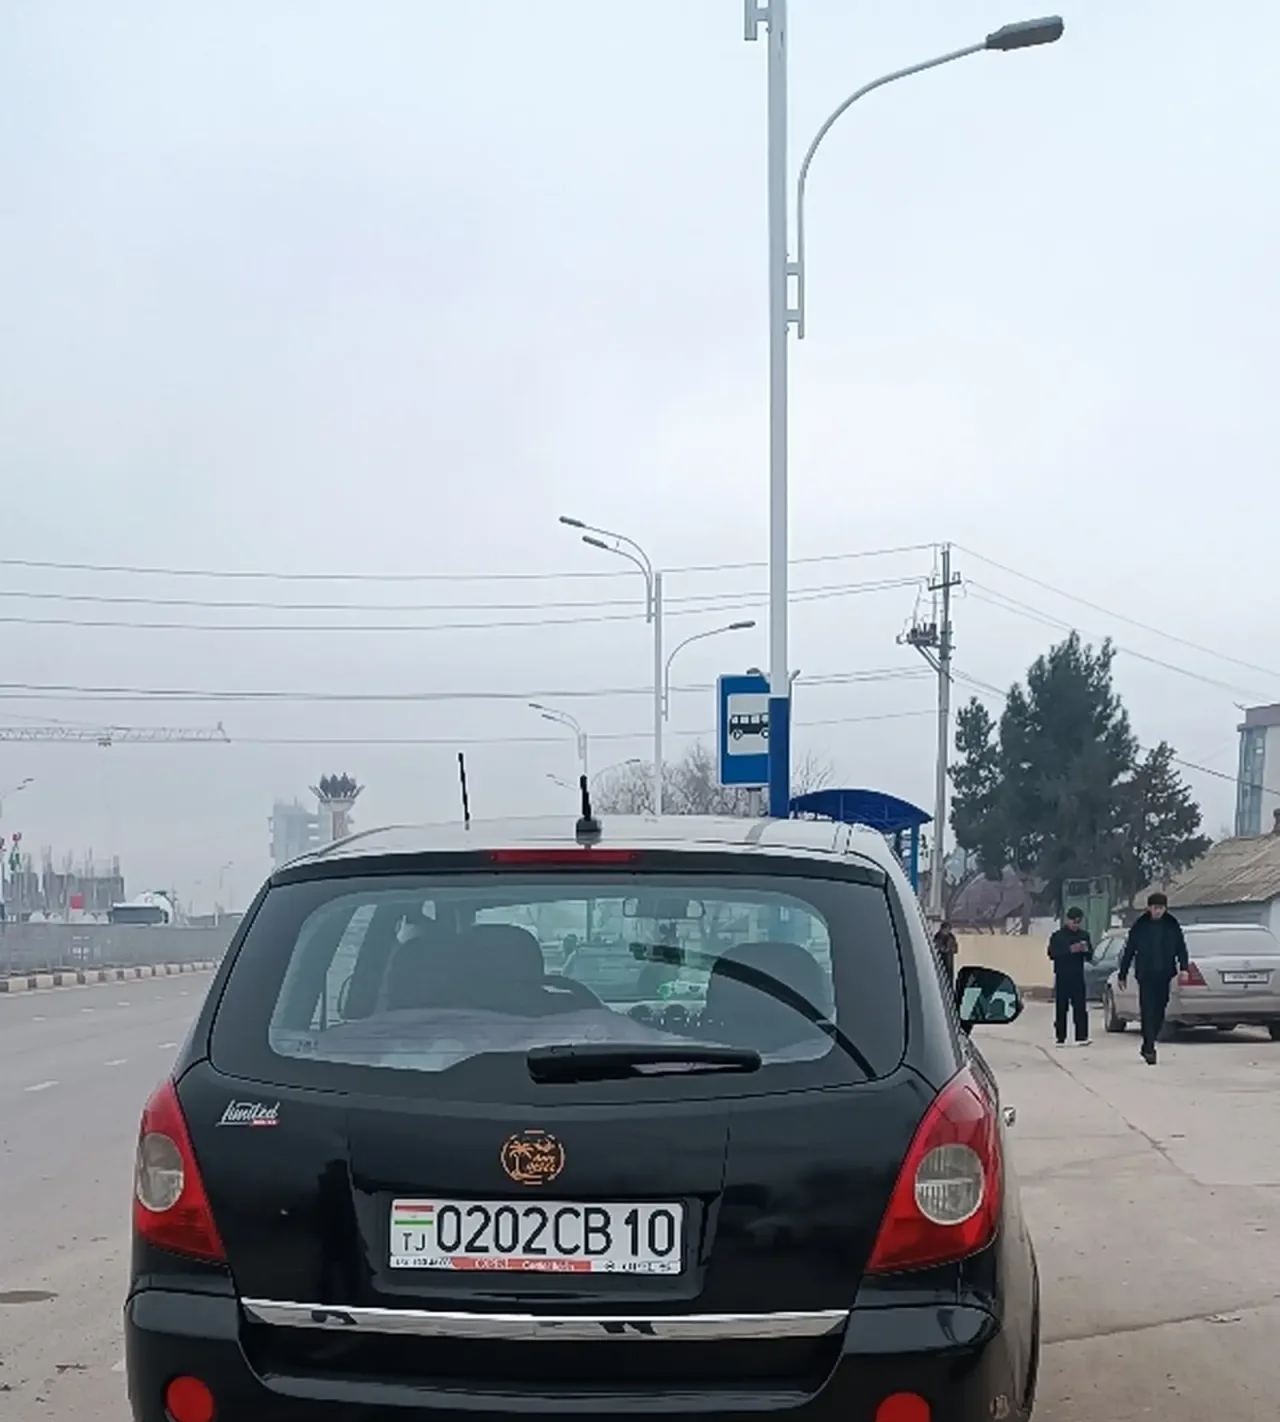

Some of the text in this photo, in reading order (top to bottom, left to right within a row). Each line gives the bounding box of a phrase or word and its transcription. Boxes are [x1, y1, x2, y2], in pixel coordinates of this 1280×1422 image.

[402, 1232, 427, 1251] TJ
[436, 1204, 676, 1257] 0202CB 10
